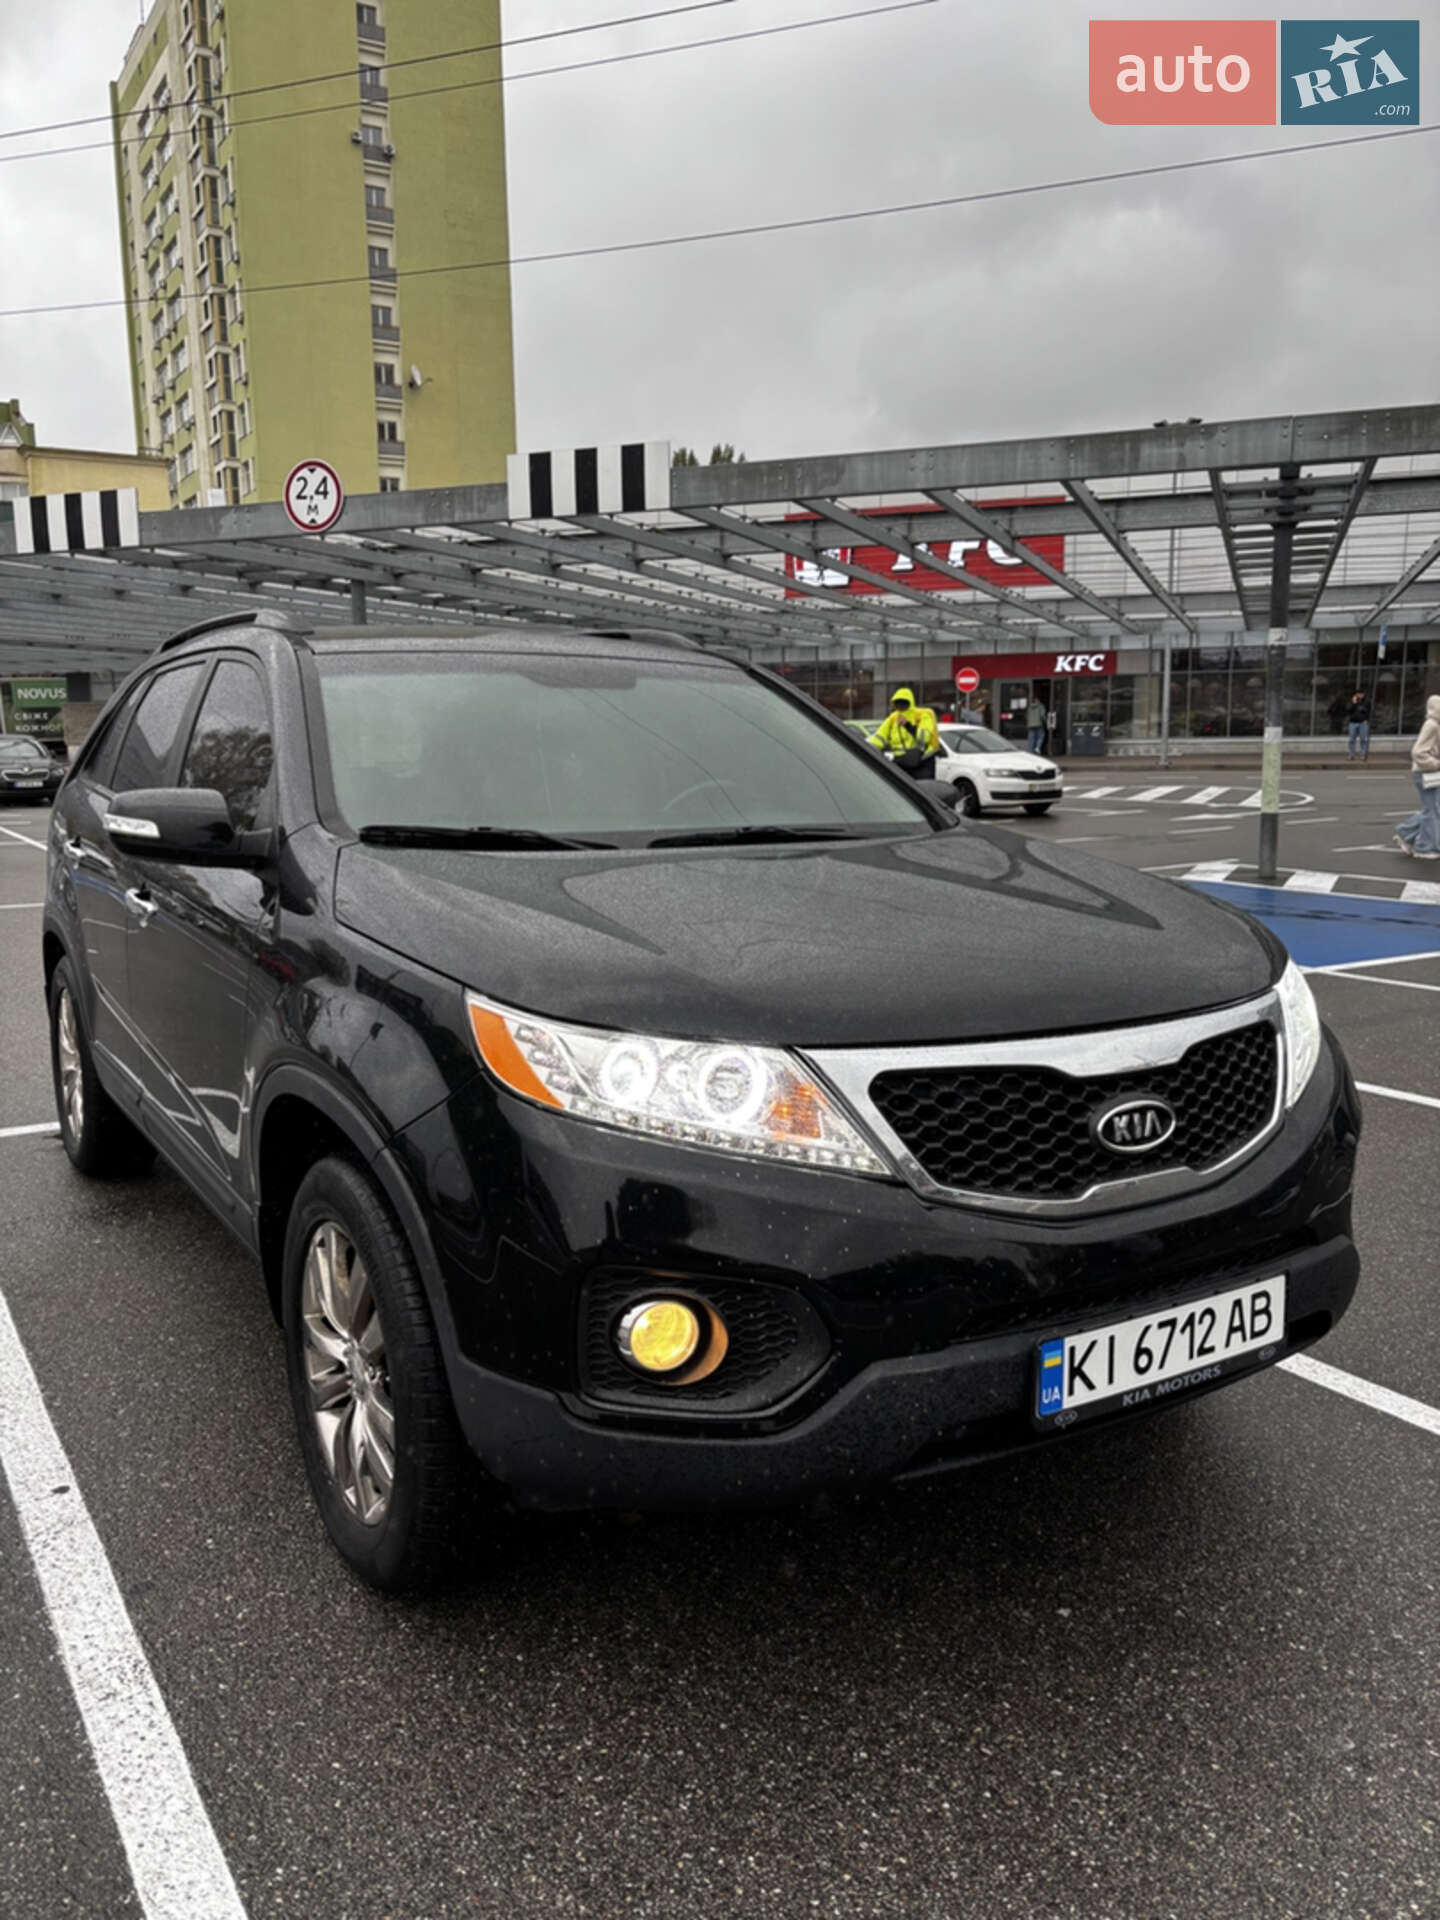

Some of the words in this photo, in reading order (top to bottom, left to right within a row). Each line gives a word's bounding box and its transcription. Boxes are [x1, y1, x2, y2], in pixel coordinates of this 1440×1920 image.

[296, 475, 329, 502] 2,4
[1054, 653, 1106, 673] KFC
[16, 687, 68, 700] NOVUS
[1112, 1109, 1162, 1143] KIA
[1067, 1334, 1116, 1397] KI
[1133, 1307, 1216, 1375] 6712
[1225, 1289, 1273, 1349] AB
[1042, 1386, 1061, 1404] UA
[1122, 1389, 1151, 1407] KIA
[1155, 1366, 1222, 1397] MOTORS
